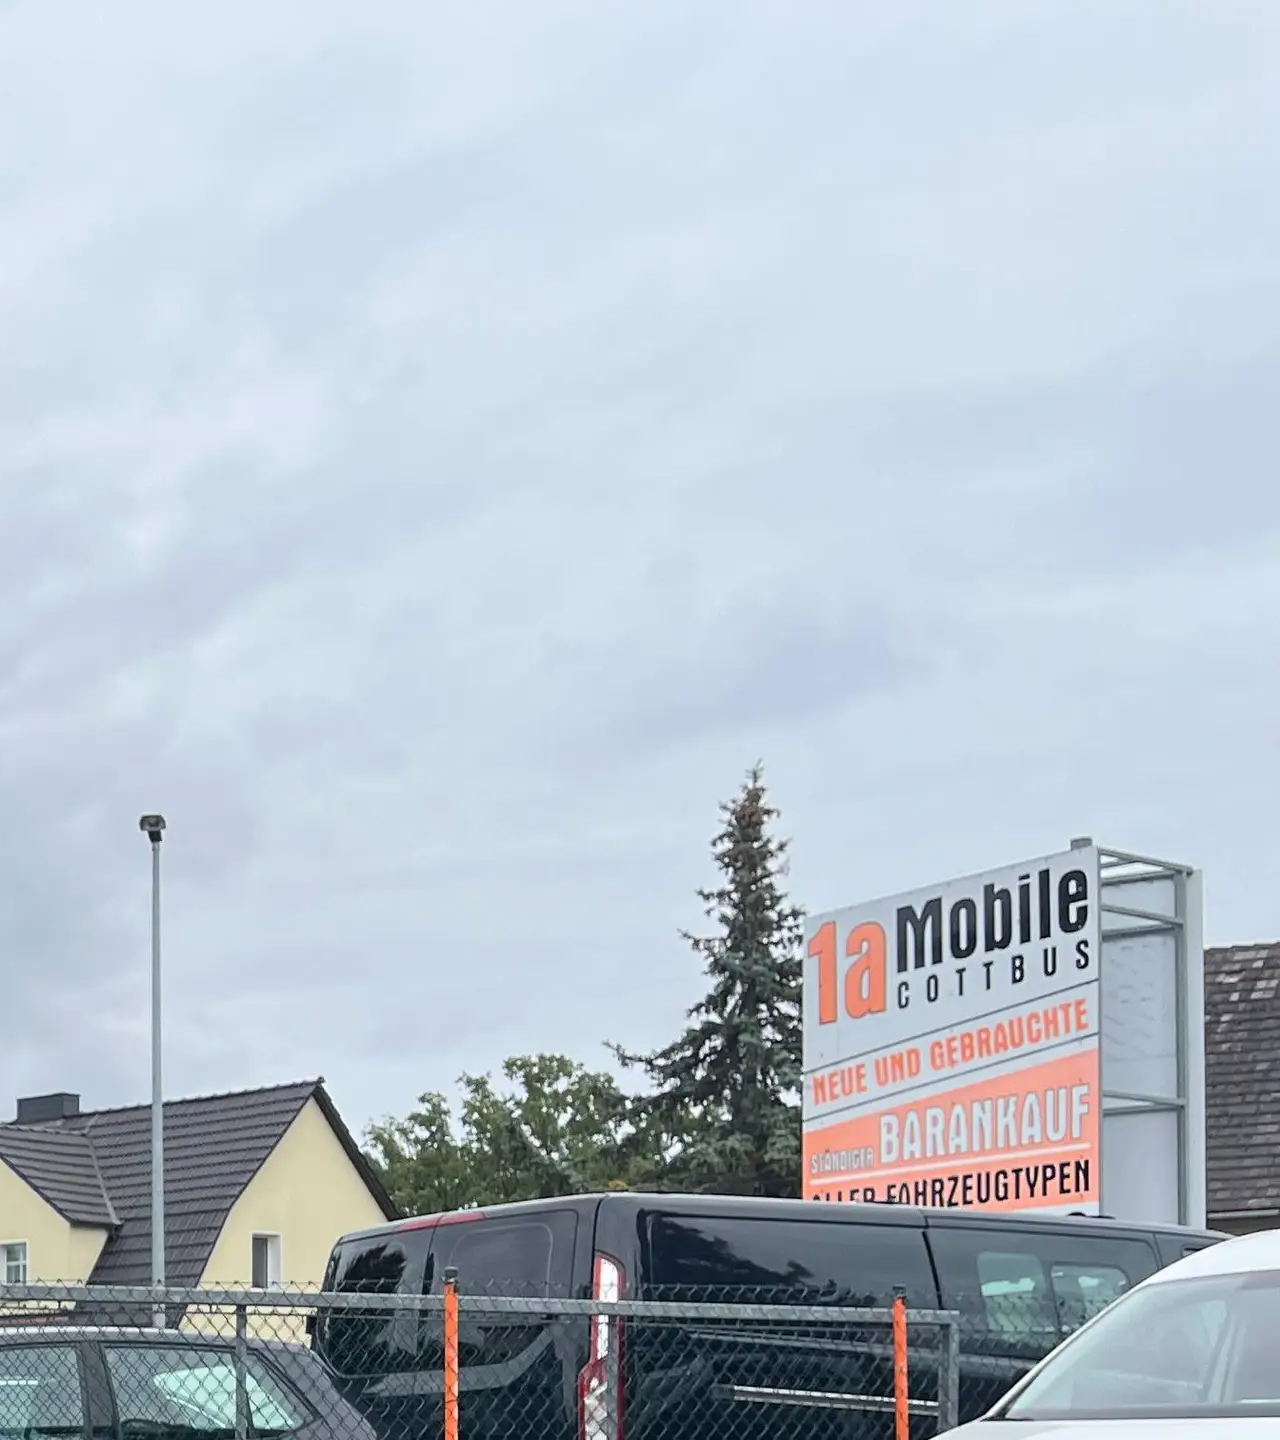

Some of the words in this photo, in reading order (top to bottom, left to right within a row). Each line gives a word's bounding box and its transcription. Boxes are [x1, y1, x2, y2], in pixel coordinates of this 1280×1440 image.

[897, 939, 1090, 1010] COTTBUS
[811, 1063, 867, 1106] NEUE
[874, 1047, 922, 1087] UND
[930, 998, 1089, 1070] GEBRAUCHTE
[880, 1083, 1090, 1164] BARANKAUF
[887, 1160, 1090, 1208] FAHRZEUGTYPEN
